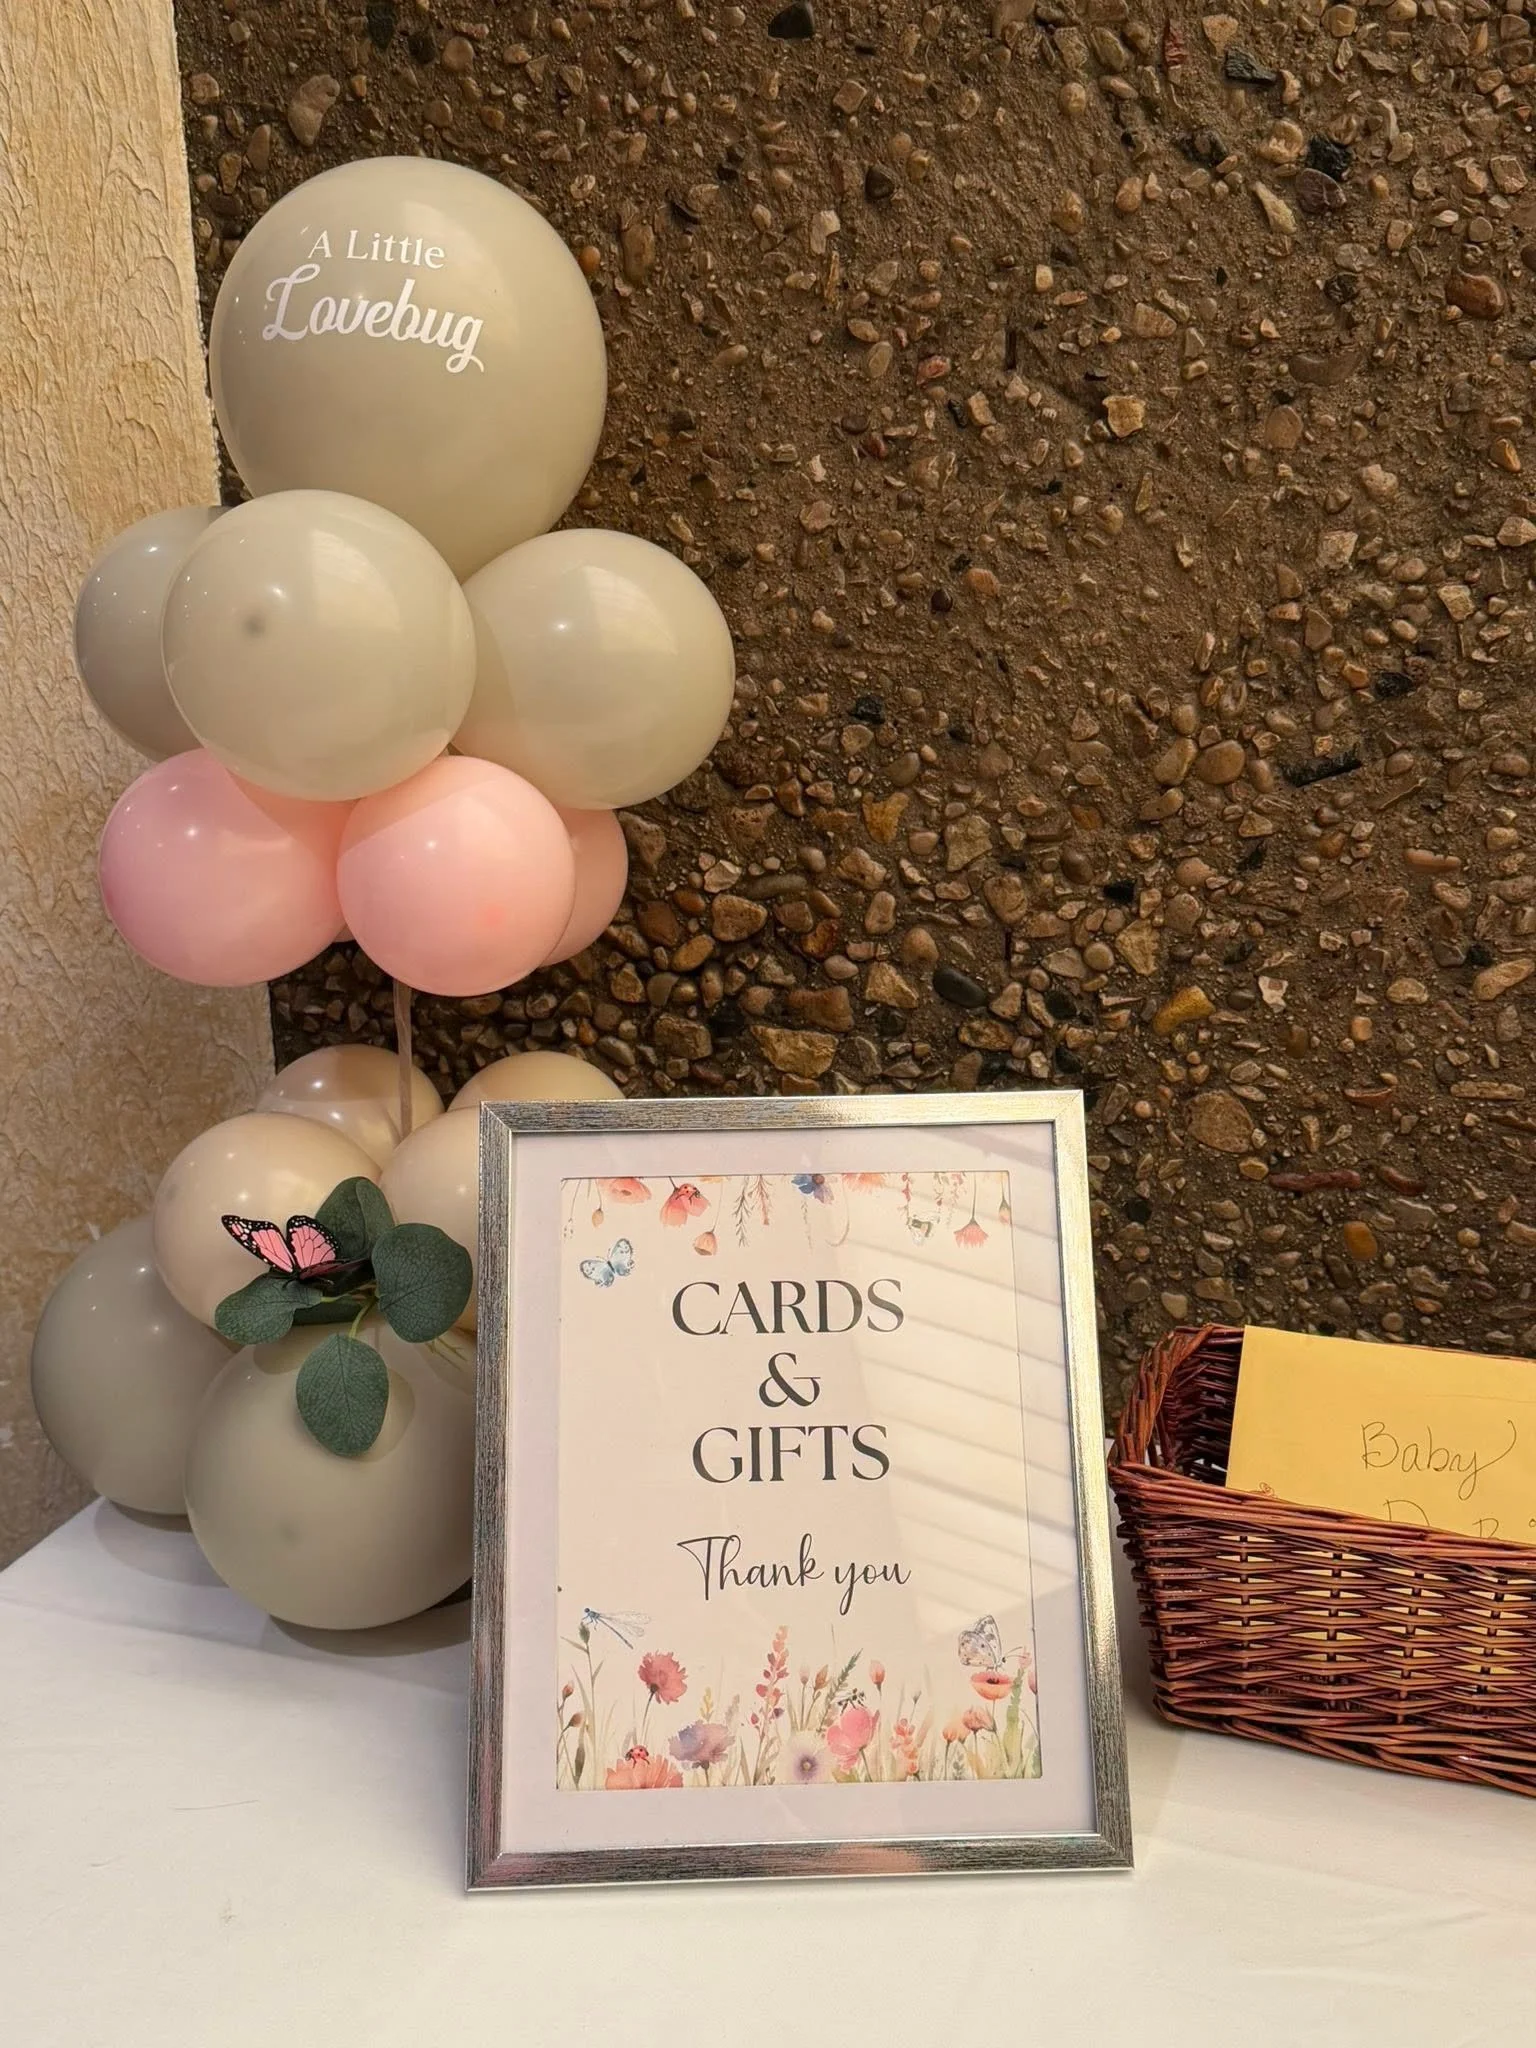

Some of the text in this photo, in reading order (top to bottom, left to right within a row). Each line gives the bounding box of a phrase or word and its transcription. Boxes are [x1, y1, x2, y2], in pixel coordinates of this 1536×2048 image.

[308, 230, 446, 269] A Little
[262, 263, 485, 373] Lovebug
[672, 1278, 905, 1336] CARDS
[758, 1352, 821, 1408] &
[692, 1424, 891, 1483] GIFTS
[1361, 1420, 1517, 1501] Baby
[676, 1533, 912, 1616] Thank you
